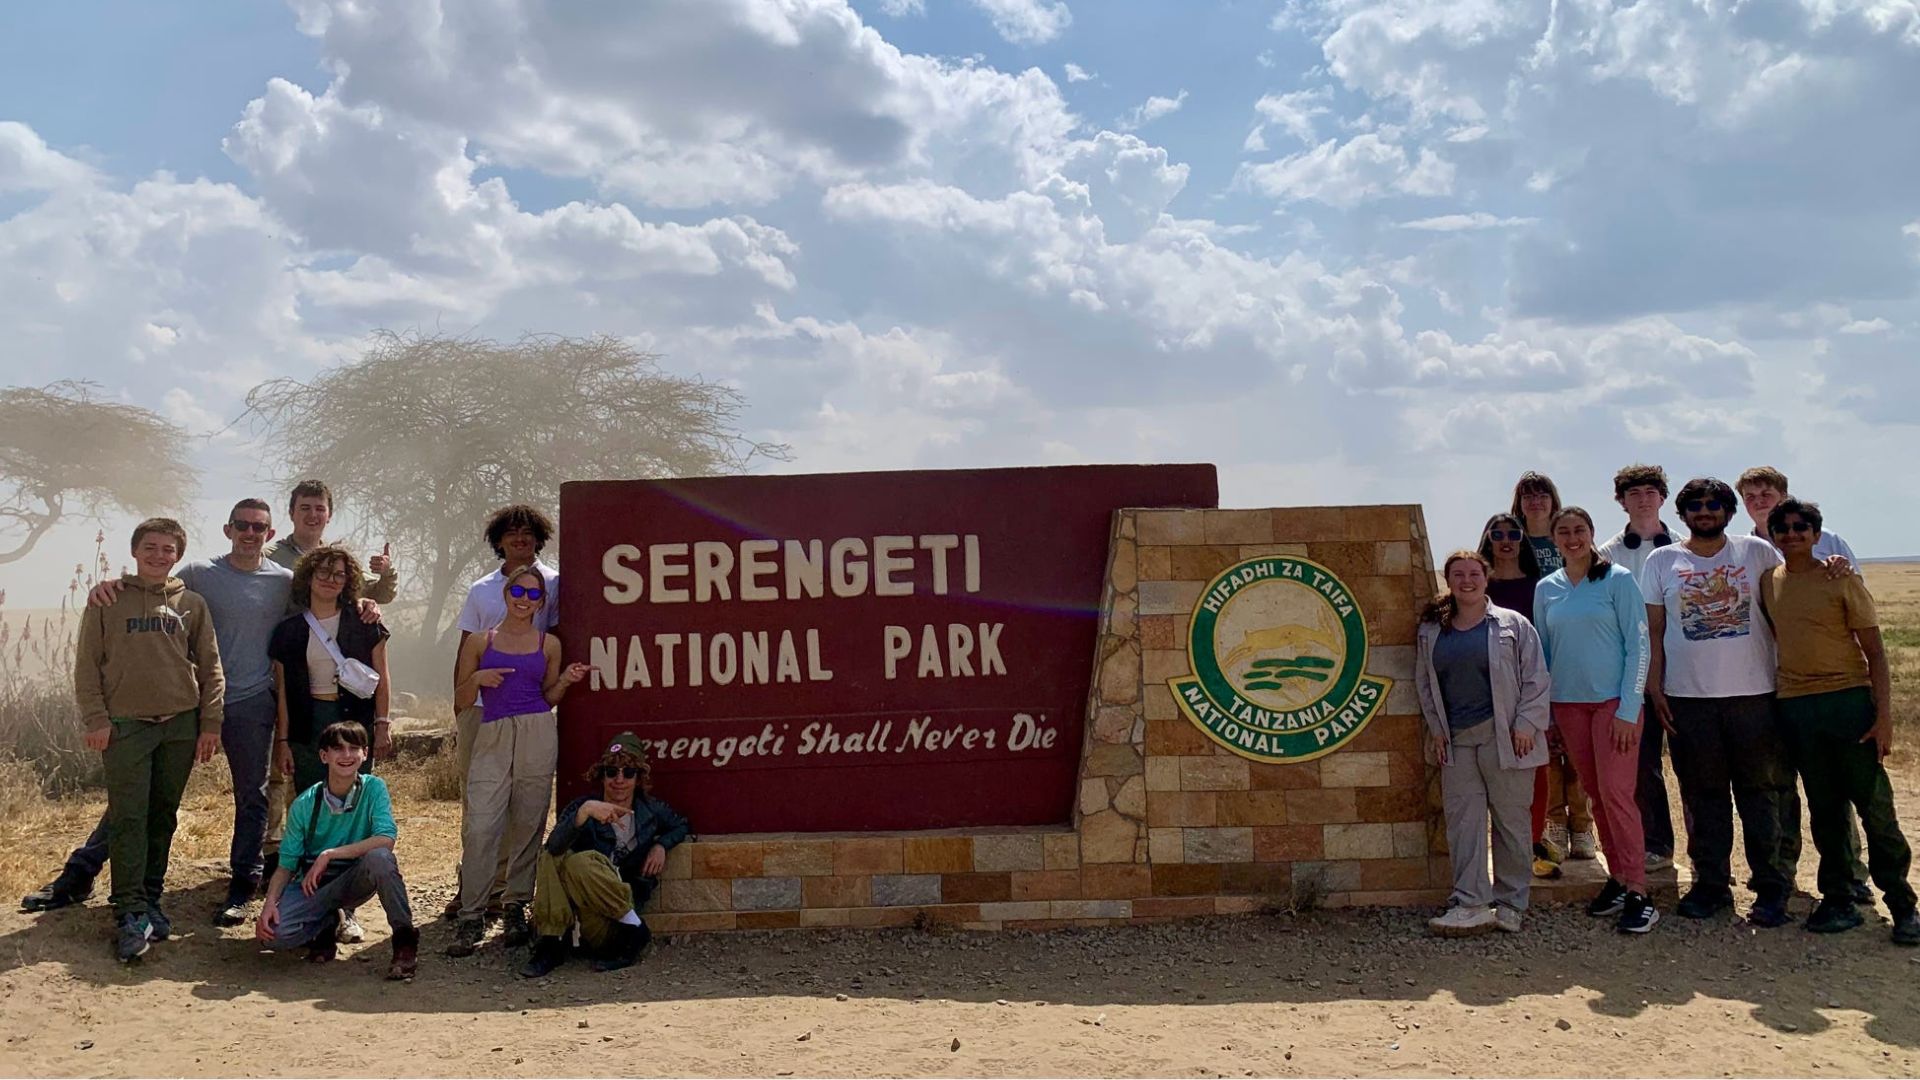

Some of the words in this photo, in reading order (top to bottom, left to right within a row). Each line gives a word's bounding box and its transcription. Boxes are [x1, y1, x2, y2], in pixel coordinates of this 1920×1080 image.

[602, 534, 980, 604] SERENGETI
[1203, 562, 1274, 614] HIFADHI
[1282, 562, 1303, 578] ZA
[1312, 571, 1353, 618] TAIFA
[590, 628, 833, 691] NATIONAL
[884, 622, 1007, 680] PARK
[641, 723, 789, 767] erengeti
[798, 720, 893, 754] Shall
[896, 716, 996, 753] Never
[1007, 712, 1057, 751] Die
[1184, 686, 1284, 754] NATIONAL
[1313, 684, 1378, 746] PARKS
[1227, 695, 1336, 730] TANZANIA
